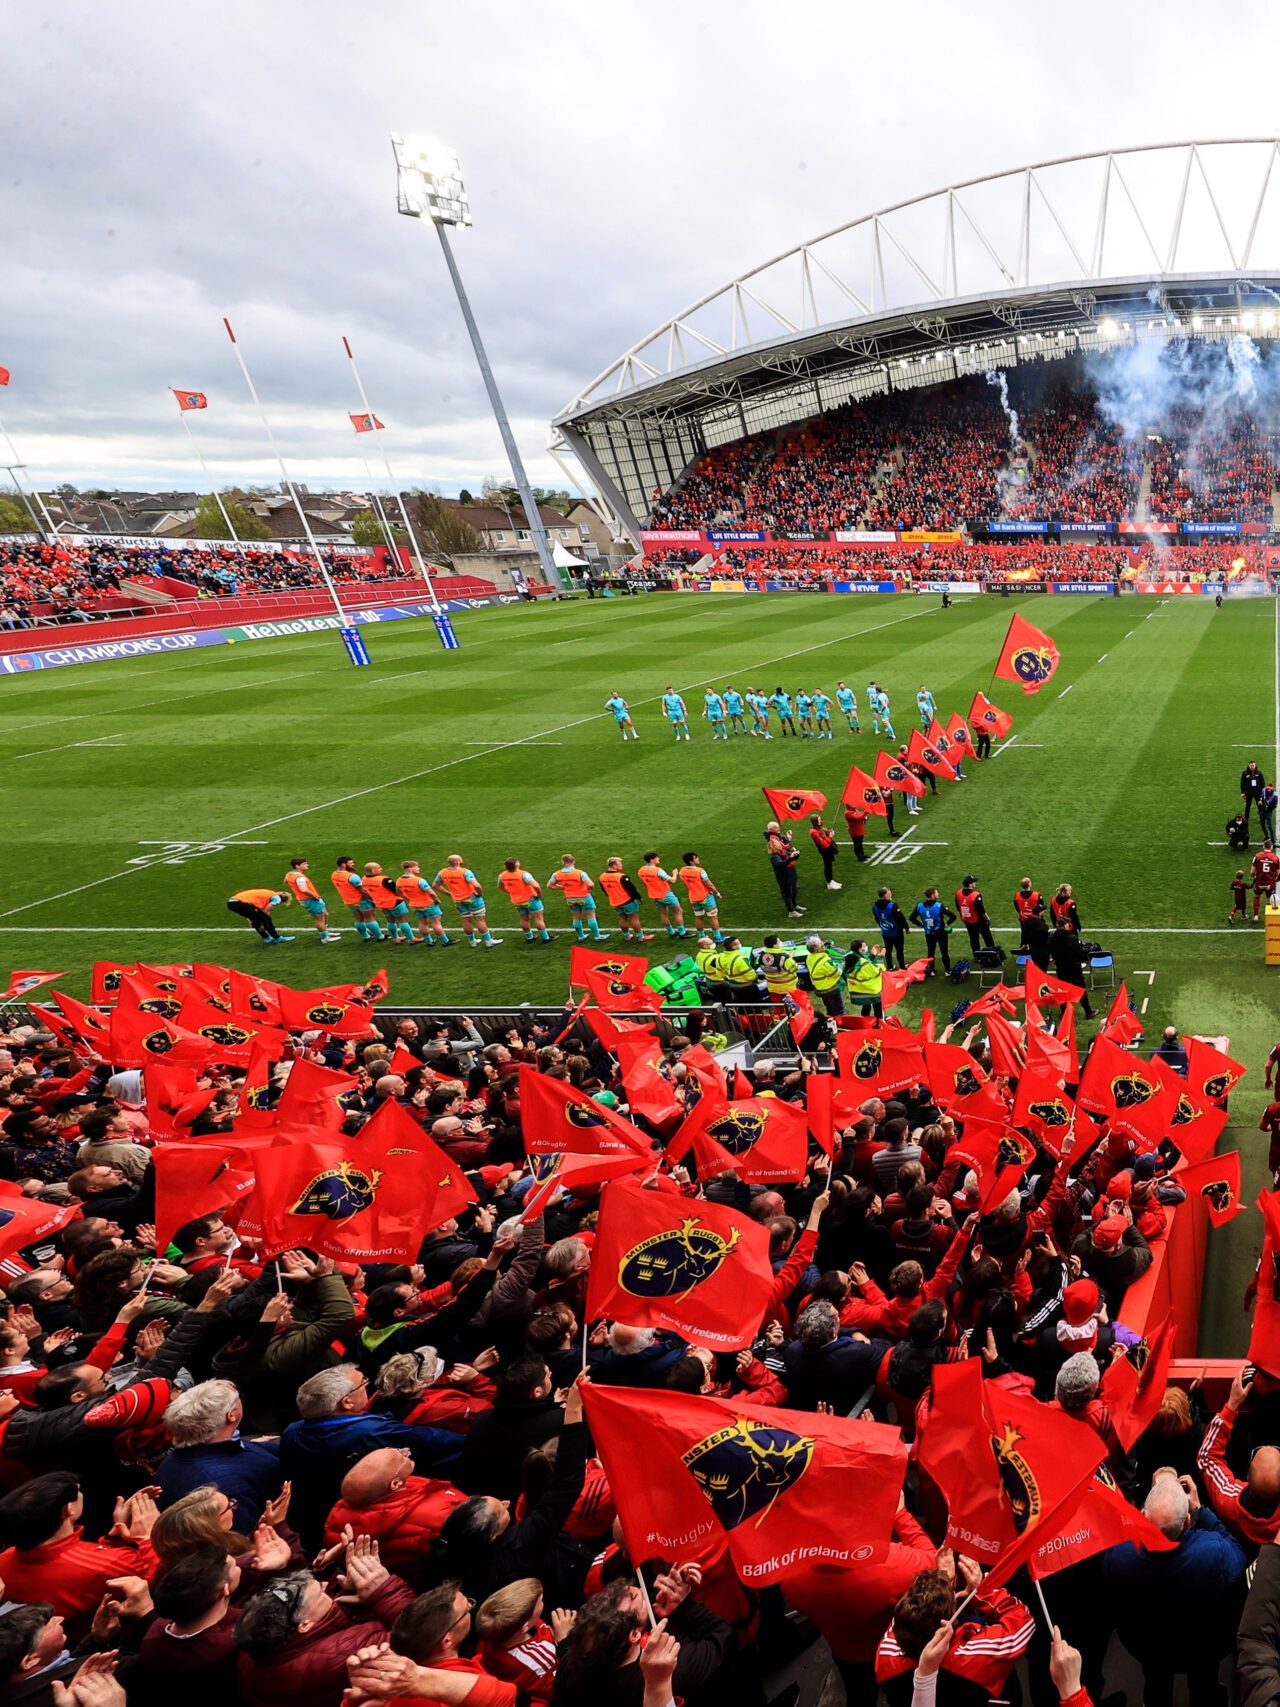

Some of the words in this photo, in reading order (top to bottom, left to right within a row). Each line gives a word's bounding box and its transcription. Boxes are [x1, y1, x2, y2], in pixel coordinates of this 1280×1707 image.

[659, 531, 700, 540] healthcare
[1216, 524, 1237, 532] Ireland
[856, 584, 880, 593] inver
[238, 616, 342, 640] Heineken
[44, 638, 162, 665] CHAMPIONS
[161, 633, 198, 649] CUP
[126, 843, 226, 865] 22
[864, 844, 924, 866] 10
[1262, 862, 1271, 873] 6
[763, 1168, 788, 1176] Ireland
[299, 1170, 337, 1202] MUNSTER
[355, 1247, 392, 1257] Ireland
[626, 1231, 678, 1261] MUNSTER
[692, 1230, 724, 1247] RUGBY
[660, 1311, 683, 1329] Bank
[681, 1321, 693, 1333] of
[692, 1325, 728, 1342] Ireland
[683, 1428, 732, 1467] NSTER
[1038, 1527, 1091, 1558] #BOIrugby
[742, 1554, 781, 1577] Bank
[780, 1549, 799, 1565] of
[798, 1544, 849, 1560] Ireland
